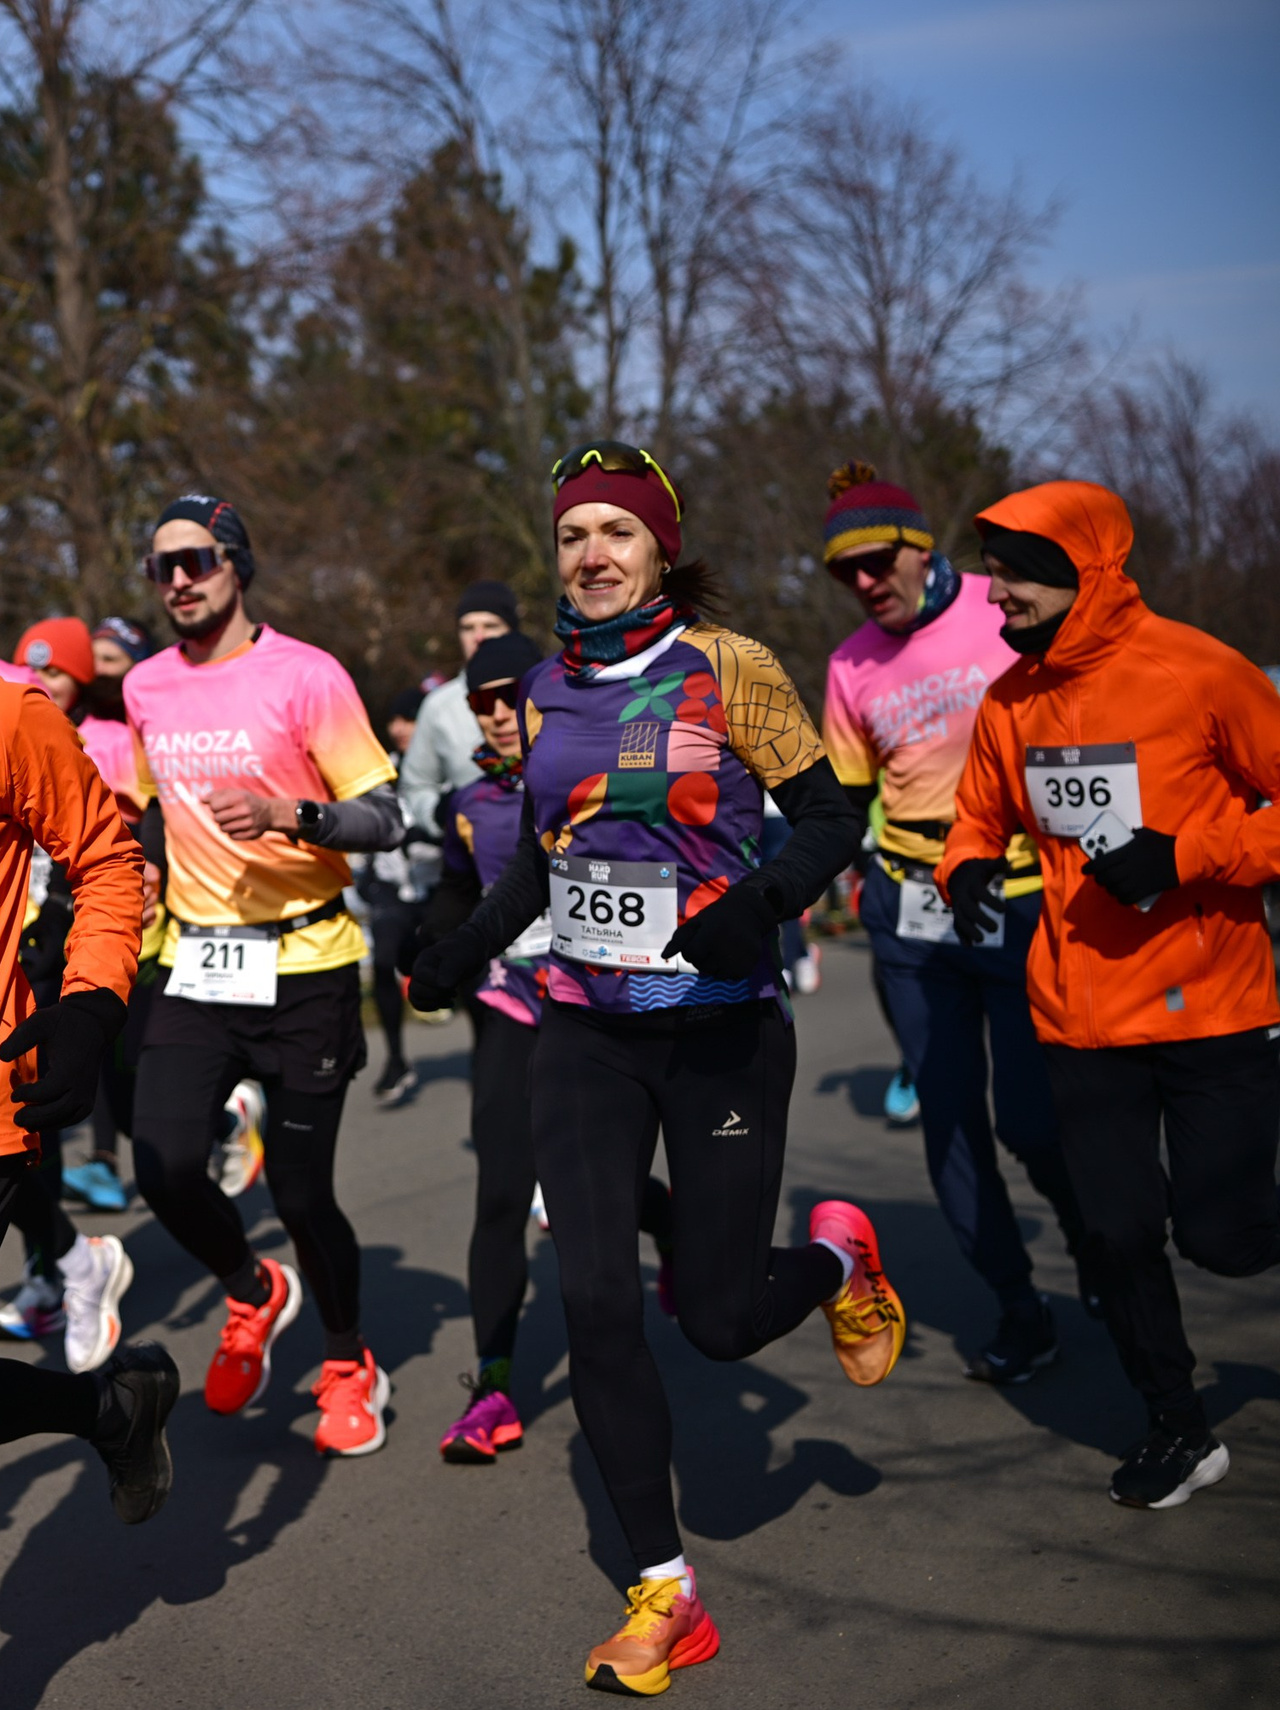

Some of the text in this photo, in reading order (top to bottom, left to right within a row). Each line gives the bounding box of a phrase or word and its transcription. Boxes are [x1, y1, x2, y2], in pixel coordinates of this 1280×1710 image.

[1045, 776, 1112, 807] 396
[588, 863, 611, 873] HARD
[591, 871, 609, 882] RUN
[567, 885, 645, 927] 268
[581, 925, 624, 939] ТАТЬЯНА
[201, 941, 245, 970] 211
[712, 1128, 750, 1137] DEMIX
